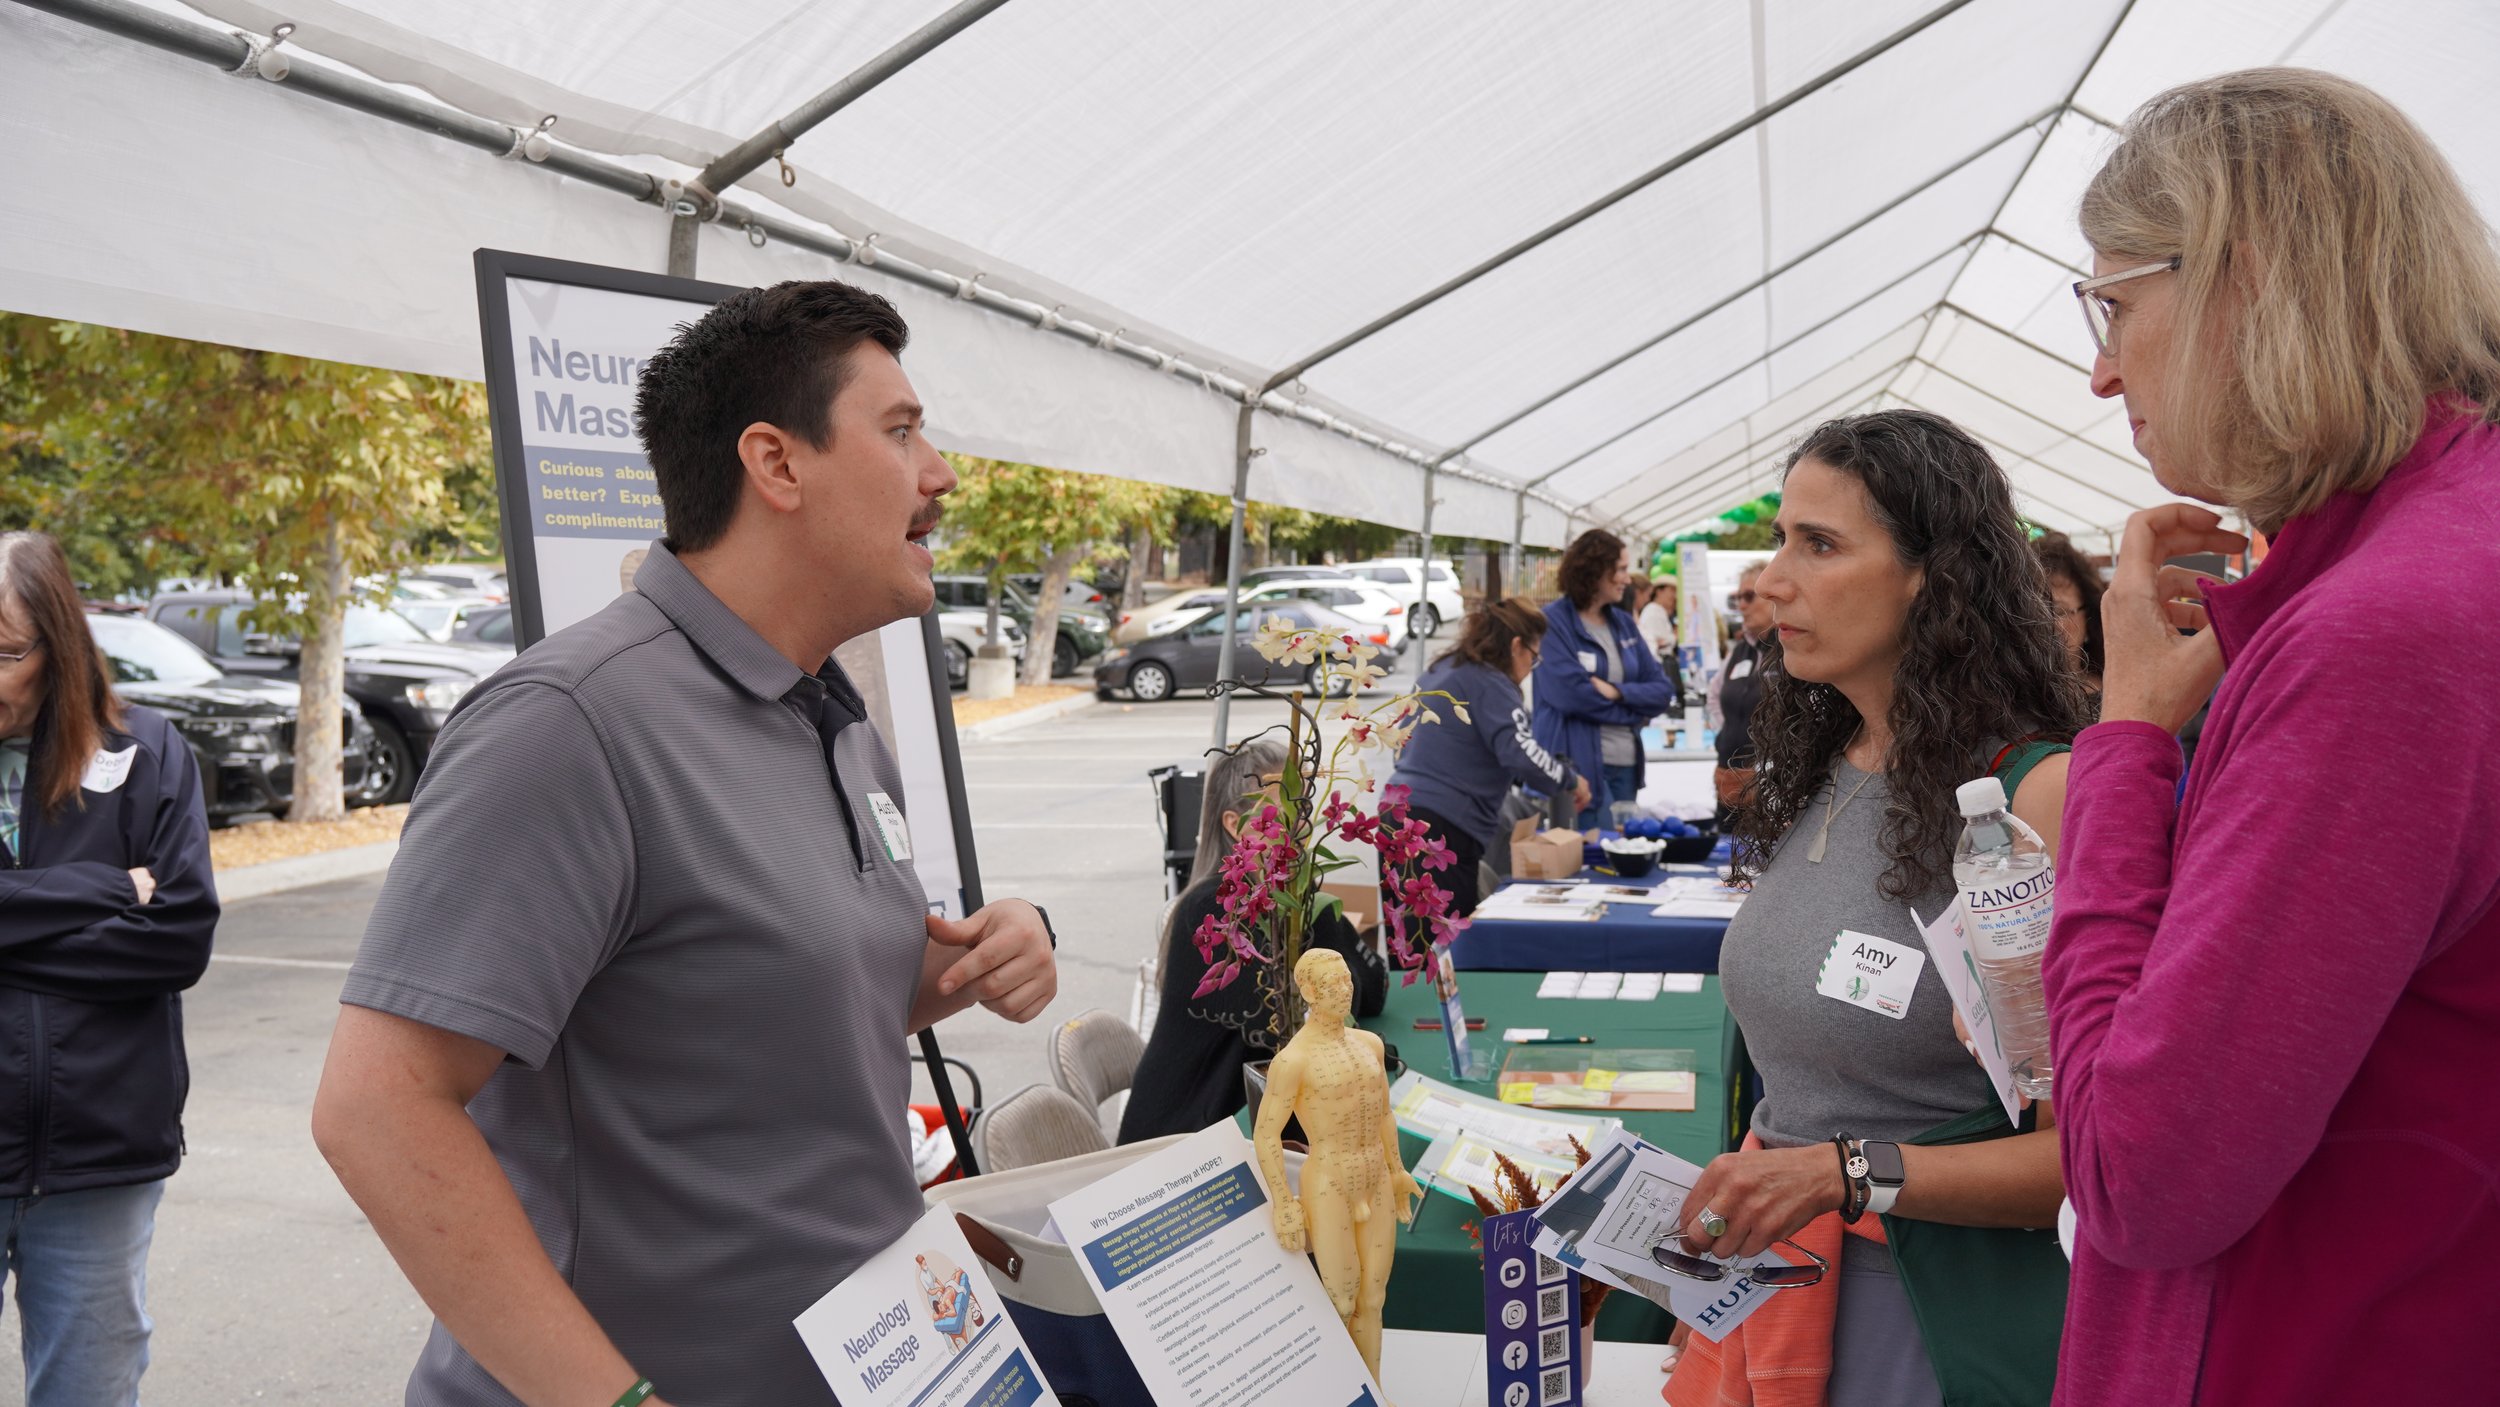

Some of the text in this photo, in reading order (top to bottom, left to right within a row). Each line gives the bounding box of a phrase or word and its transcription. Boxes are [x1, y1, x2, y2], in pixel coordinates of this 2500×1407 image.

[540, 460, 657, 480] Curious abou
[542, 485, 664, 507] better? Expe
[1968, 866, 2054, 908] ZANOTTO
[1982, 898, 2050, 921] MARKE
[1995, 916, 2031, 929] NATURAL
[1852, 942, 1897, 969] Amy
[1855, 961, 1882, 977] Kinan
[1090, 1155, 1223, 1231] Why Choose Massage Therapy at HOPE?
[1494, 1220, 1521, 1252] Let's
[1696, 1261, 1766, 1327] HOP
[843, 1298, 911, 1363] Neurology
[859, 1333, 920, 1394] Massage
[945, 1341, 1001, 1403] Therapy for Stroke Recovery
